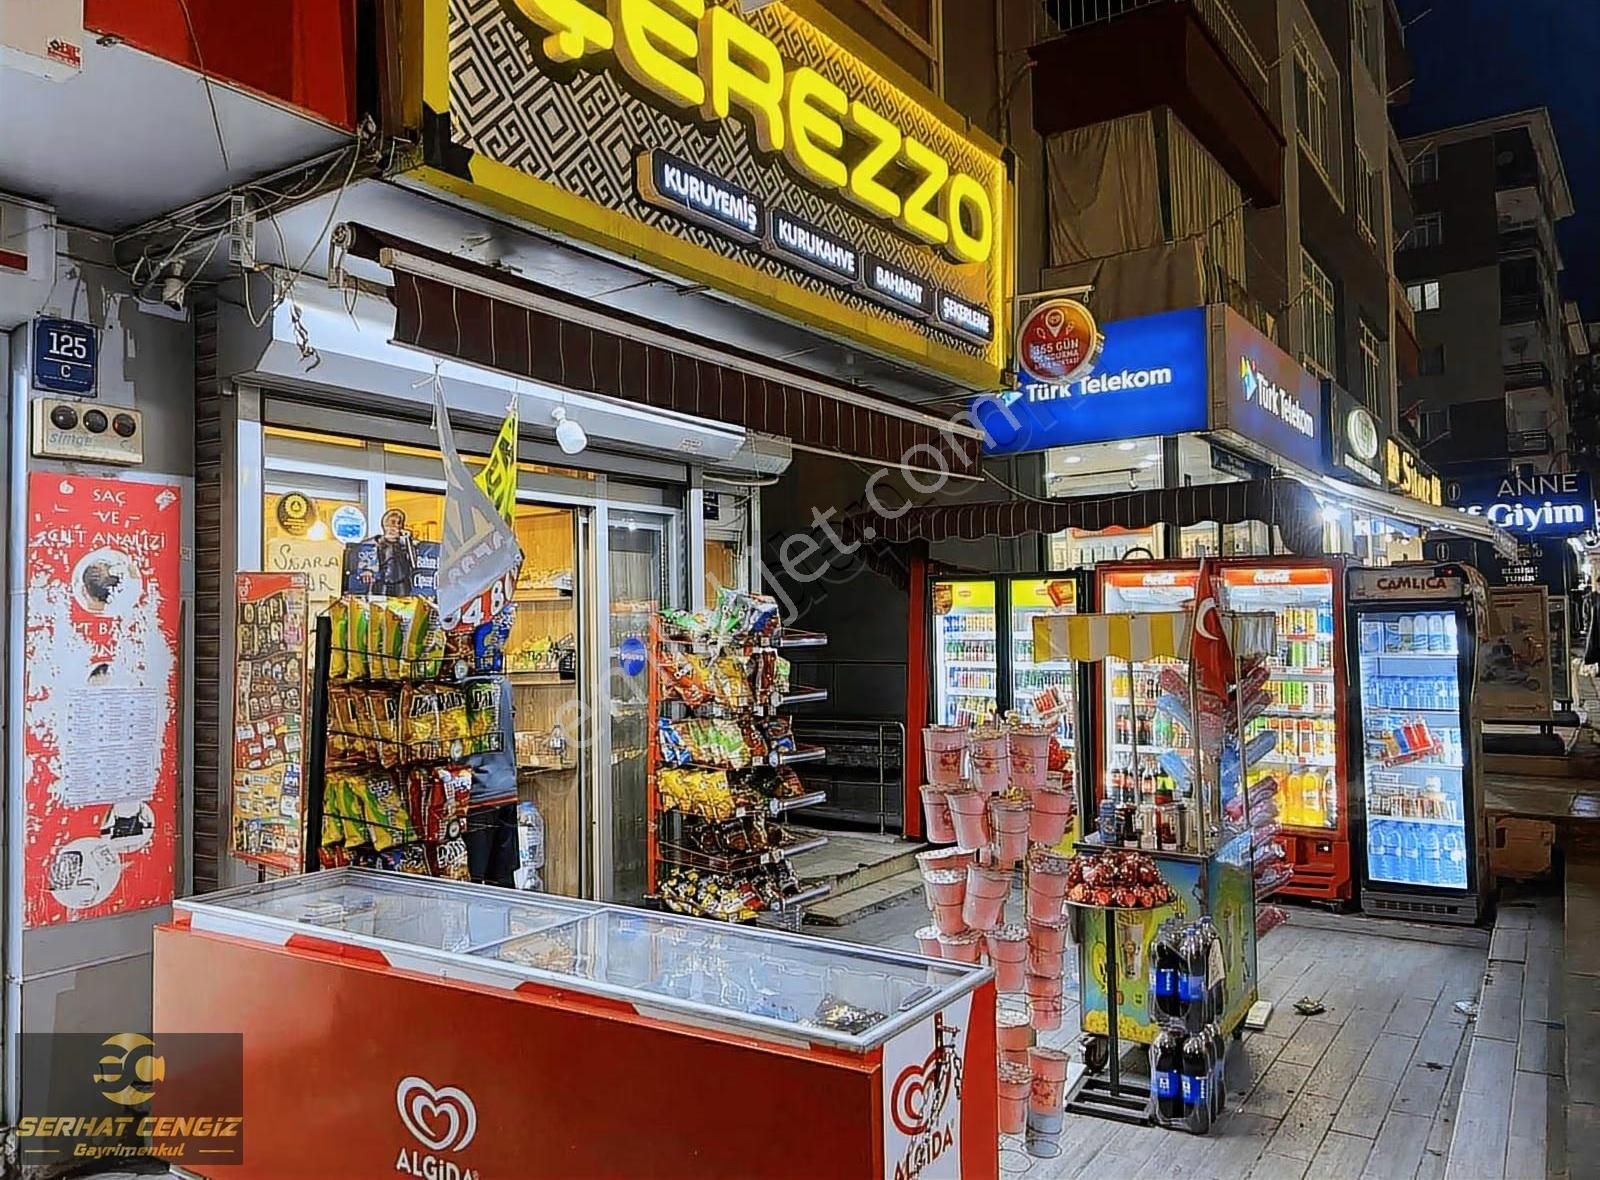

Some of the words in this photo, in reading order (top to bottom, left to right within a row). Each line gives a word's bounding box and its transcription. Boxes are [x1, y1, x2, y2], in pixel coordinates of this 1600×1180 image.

[663, 163, 758, 231] KURUYEMİŞ
[777, 218, 855, 272] KURUKAHVE
[875, 266, 923, 304] BAHARAT
[48, 331, 87, 359] 125
[60, 364, 71, 378] C
[1025, 382, 1072, 403] Türk
[1079, 367, 1172, 396] Telekom
[1256, 371, 1280, 416] Türk
[1279, 388, 1315, 438] Telekom
[93, 488, 126, 507] SAÇ
[1497, 473, 1579, 498] ANNE
[98, 510, 120, 525] VE
[1487, 501, 1585, 532] Giyim
